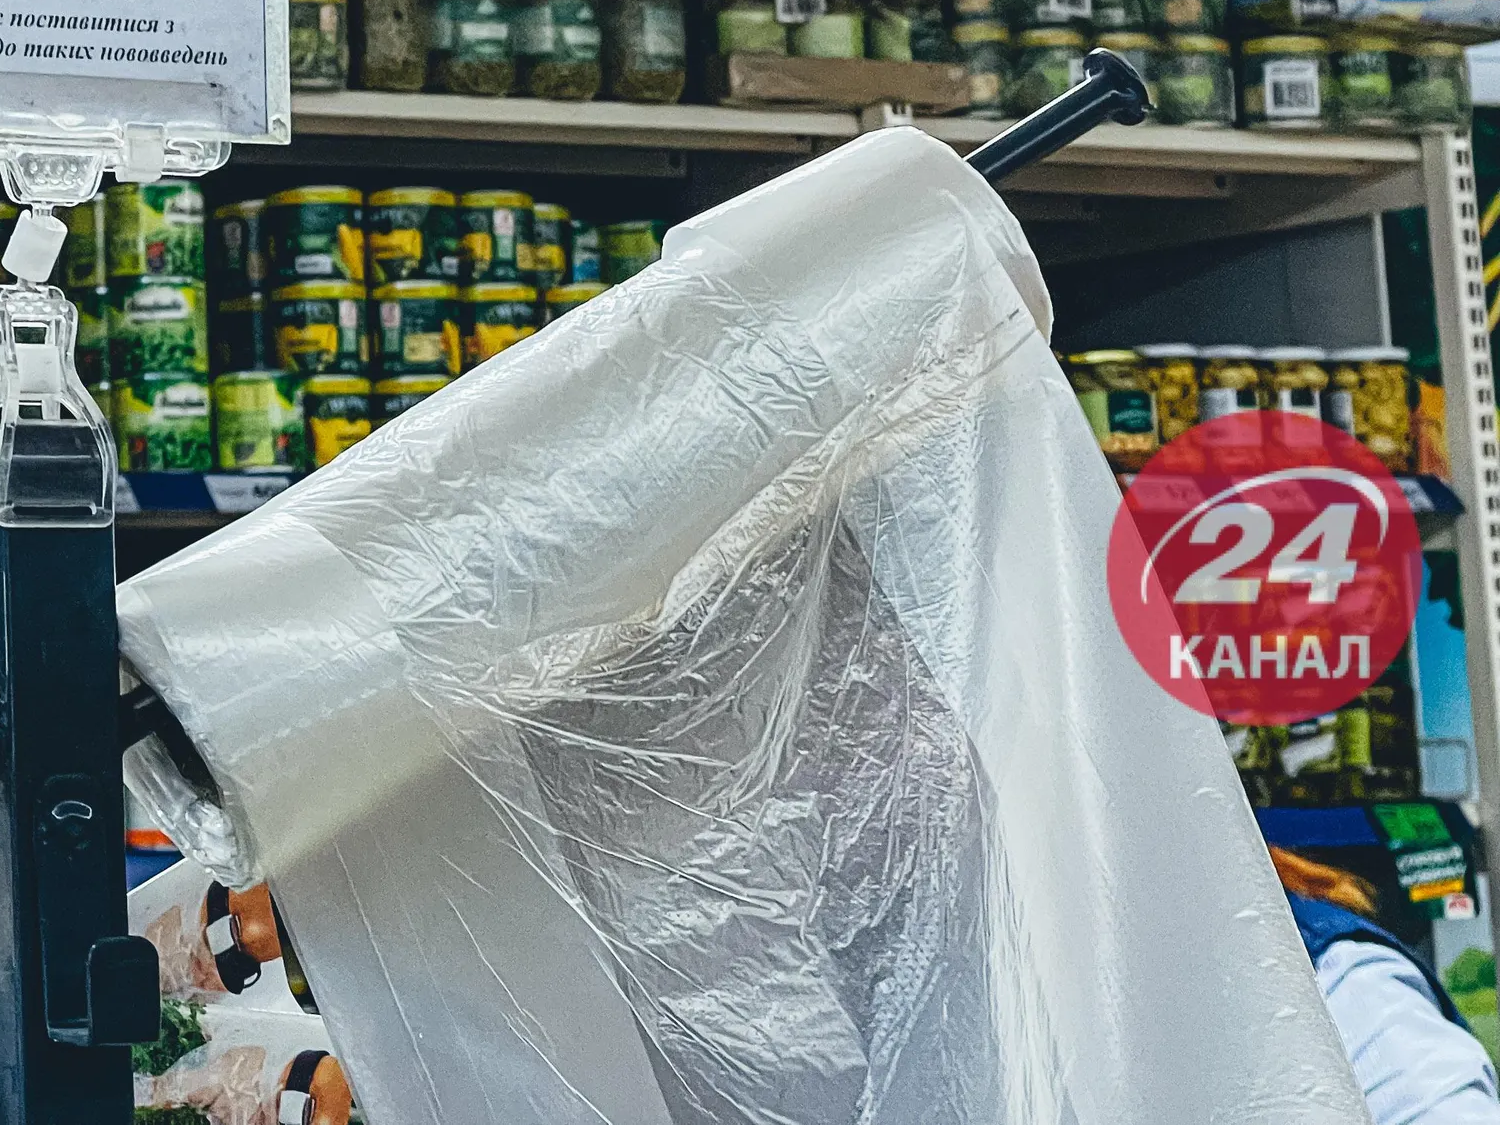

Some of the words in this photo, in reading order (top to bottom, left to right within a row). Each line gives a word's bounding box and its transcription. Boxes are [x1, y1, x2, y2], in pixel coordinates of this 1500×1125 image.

[9, 12, 159, 33] поставитися
[164, 20, 175, 34] з
[23, 43, 95, 60] таких
[100, 44, 228, 66] нововведень
